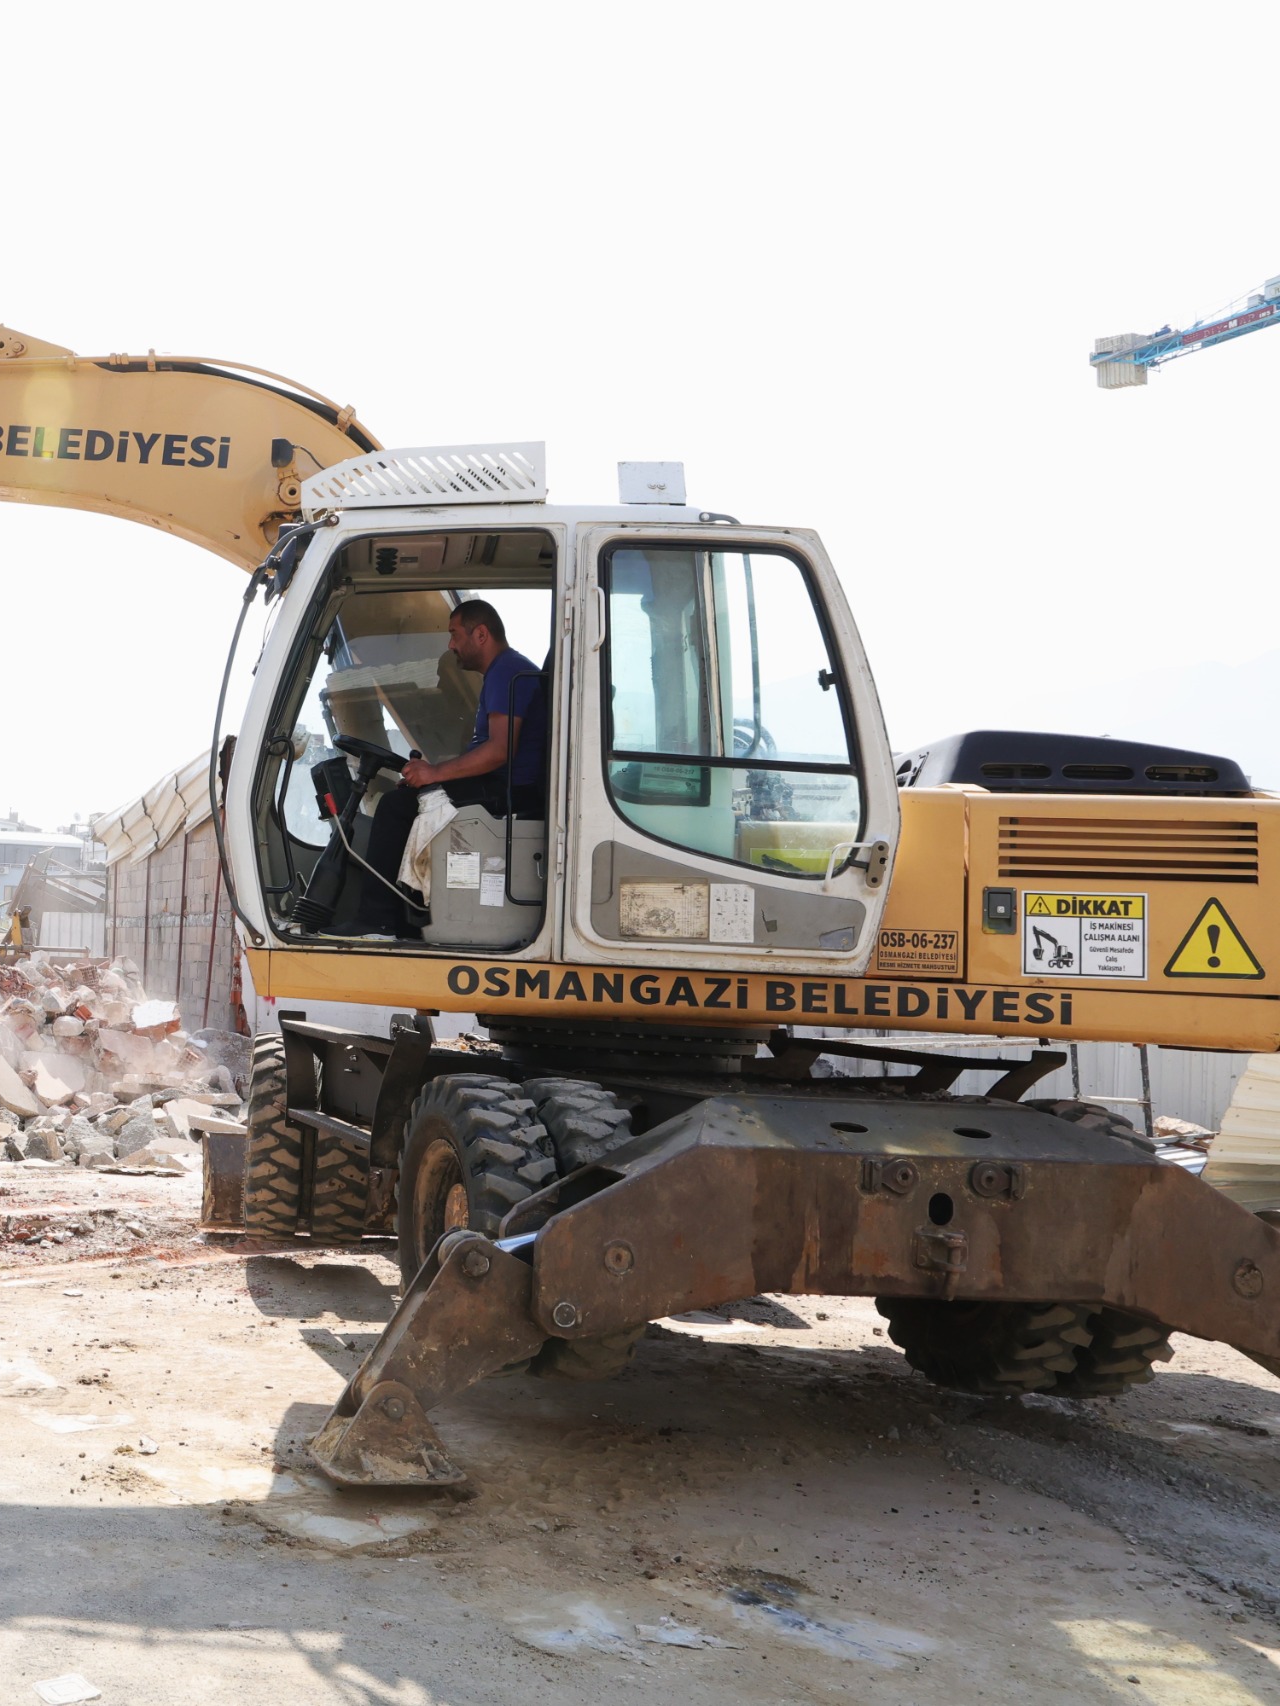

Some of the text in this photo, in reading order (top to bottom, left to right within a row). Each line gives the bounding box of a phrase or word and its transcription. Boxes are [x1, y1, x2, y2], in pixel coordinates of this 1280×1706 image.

[1056, 896, 1133, 916] DİKKAT
[1090, 921, 1134, 931] İŞ MAKİNESİ
[881, 931, 956, 949] OSB-06-237
[1083, 933, 1140, 942] ÇALIŞMA ALANI
[880, 950, 956, 961] OSMANGAZİ BELEDİYESİ
